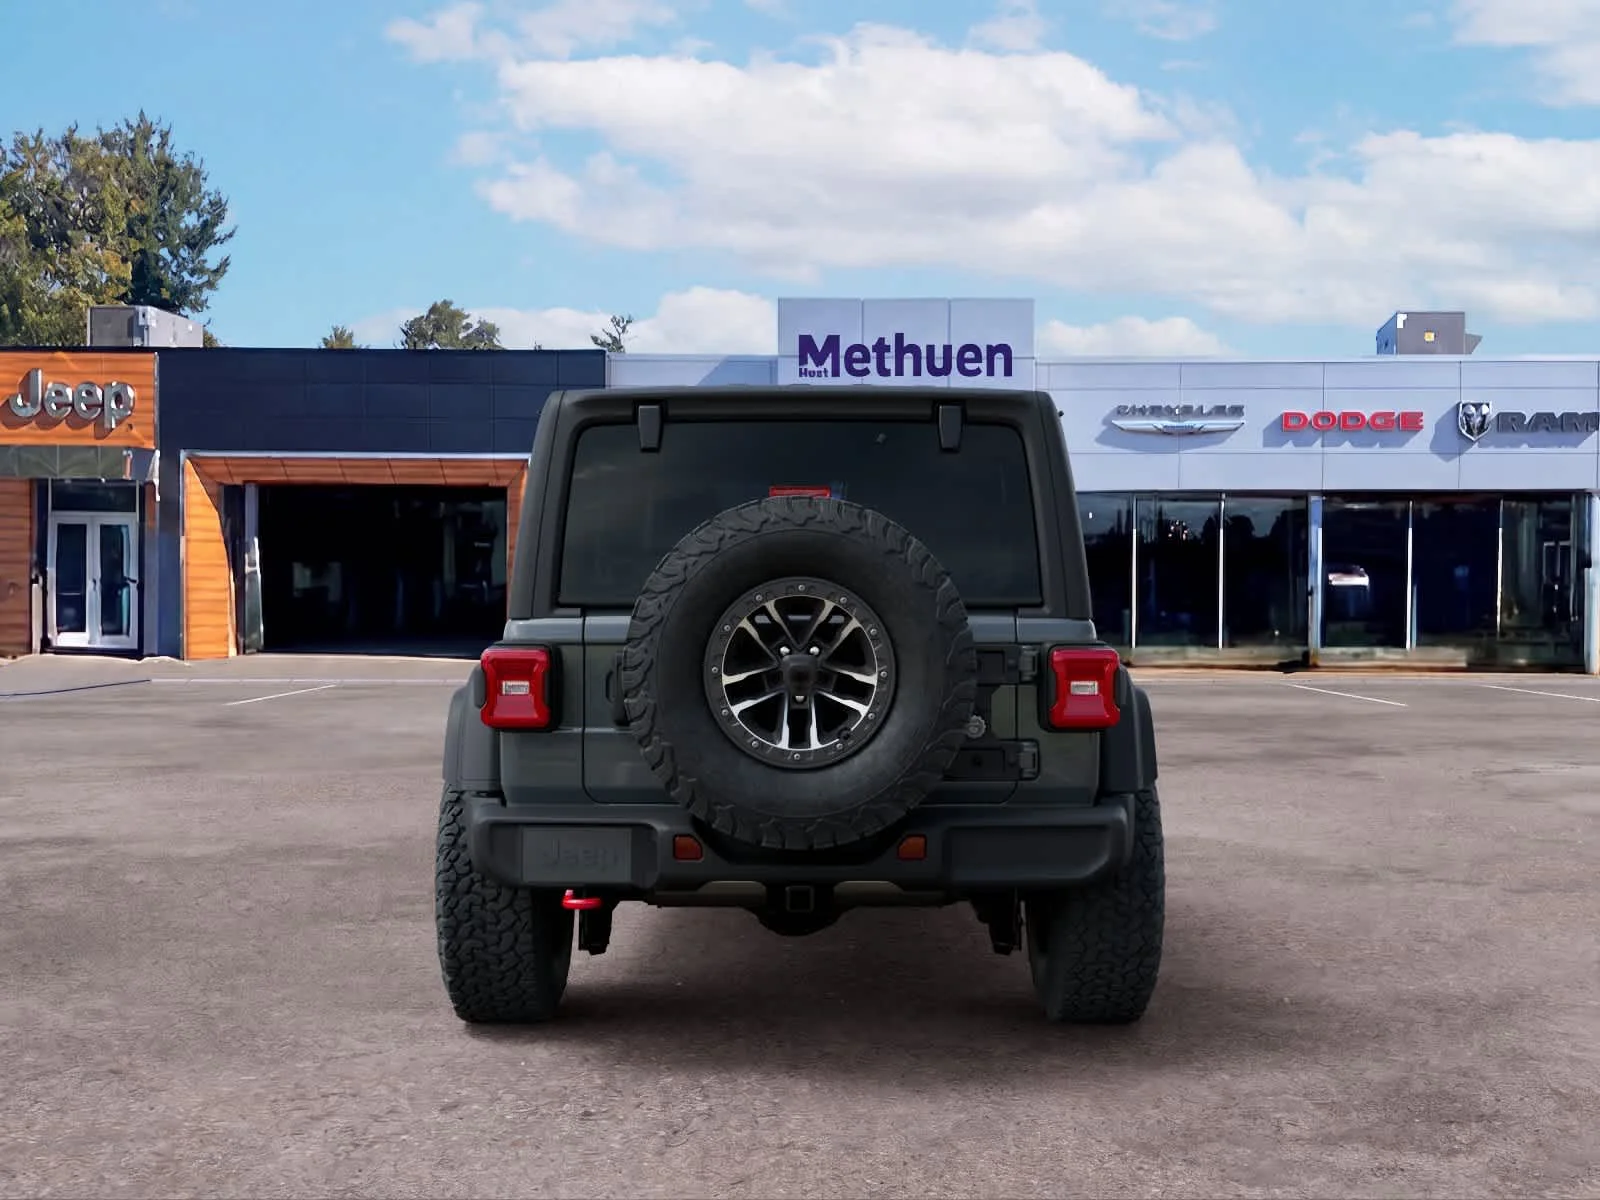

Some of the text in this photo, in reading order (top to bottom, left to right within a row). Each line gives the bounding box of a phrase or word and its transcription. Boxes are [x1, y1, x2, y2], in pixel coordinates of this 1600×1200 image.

[798, 332, 1013, 377] Methuen
[9, 368, 134, 429] Jeep
[1282, 411, 1424, 432] DODGE
[1497, 412, 1600, 432] RAM
